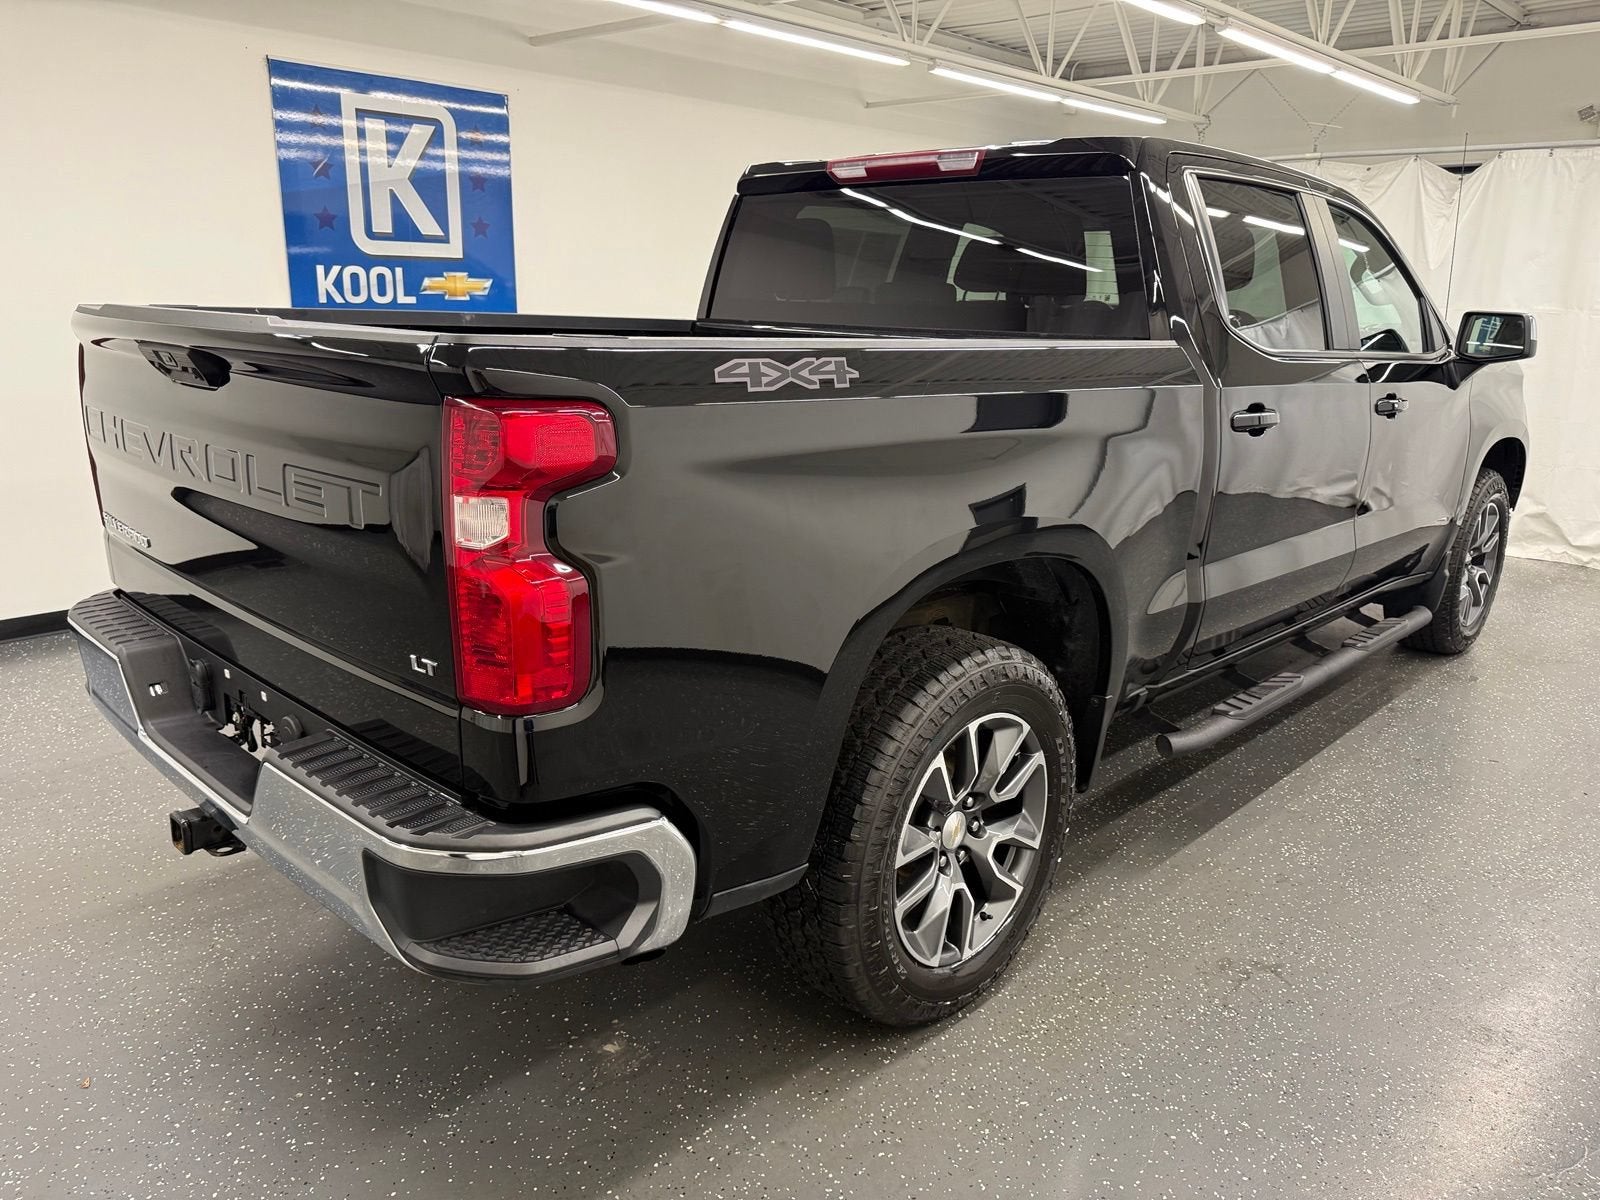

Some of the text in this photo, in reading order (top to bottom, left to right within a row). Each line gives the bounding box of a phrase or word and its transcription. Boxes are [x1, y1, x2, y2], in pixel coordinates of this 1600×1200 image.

[364, 117, 445, 236] K
[315, 264, 417, 304] KOOL
[84, 404, 382, 530] CHEVROLET
[409, 654, 438, 677] LT
